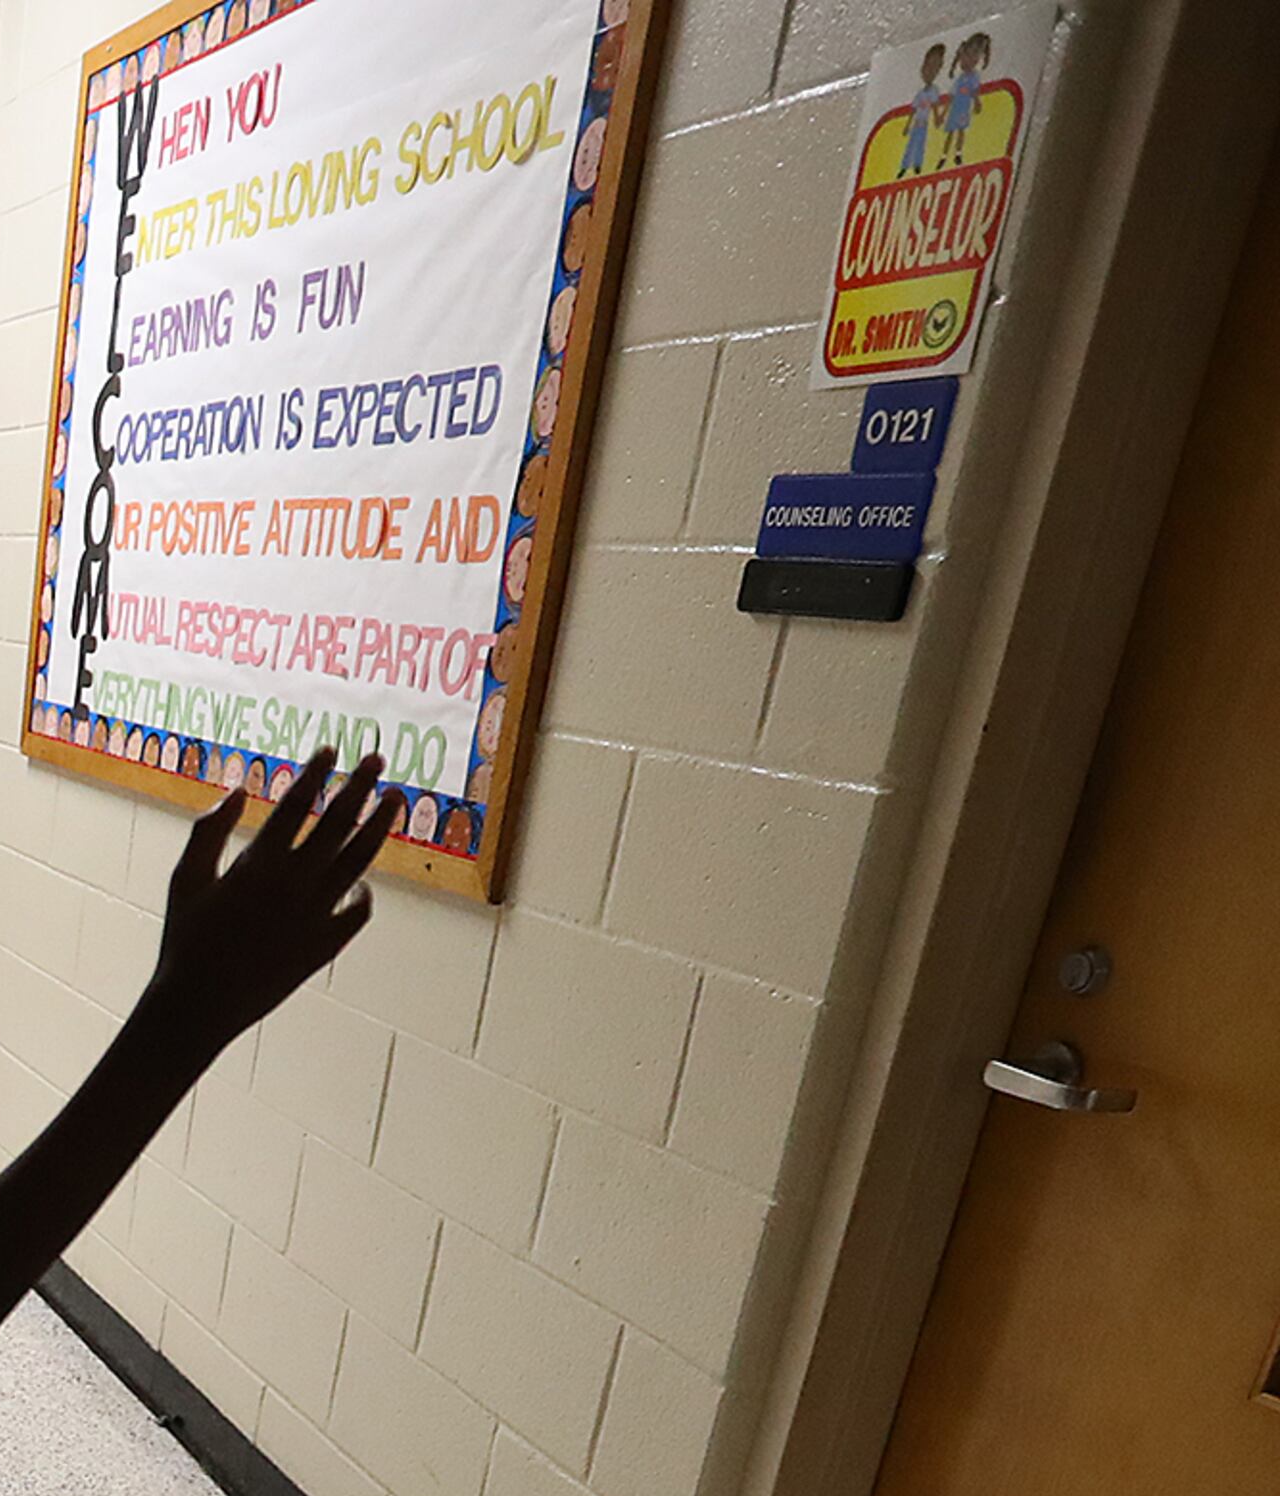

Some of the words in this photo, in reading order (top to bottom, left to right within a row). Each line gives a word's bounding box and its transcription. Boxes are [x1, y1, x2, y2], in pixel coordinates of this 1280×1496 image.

[226, 64, 282, 140] YOU
[204, 176, 262, 248] THIS
[267, 138, 382, 230] LOVING
[392, 74, 565, 195] SCHOOL
[841, 168, 1004, 283] COUNSELOR
[250, 279, 276, 341] IS
[297, 261, 366, 334] FUN
[831, 320, 856, 360] DR.
[862, 308, 927, 353] SMITH
[275, 388, 304, 450] IS
[313, 365, 503, 447] EXPECTED
[145, 498, 257, 556] POSITIVE
[261, 496, 414, 561] ATTITUDE
[416, 494, 502, 563] AND
[765, 505, 853, 528] COUNSELING
[858, 506, 914, 528] OFFICE
[175, 600, 294, 671] RESPECT
[290, 614, 354, 680] ARE
[351, 617, 445, 692] PART
[439, 627, 497, 701] OF
[210, 690, 256, 748] WE
[257, 697, 312, 760] SAY
[391, 721, 448, 790] DO
